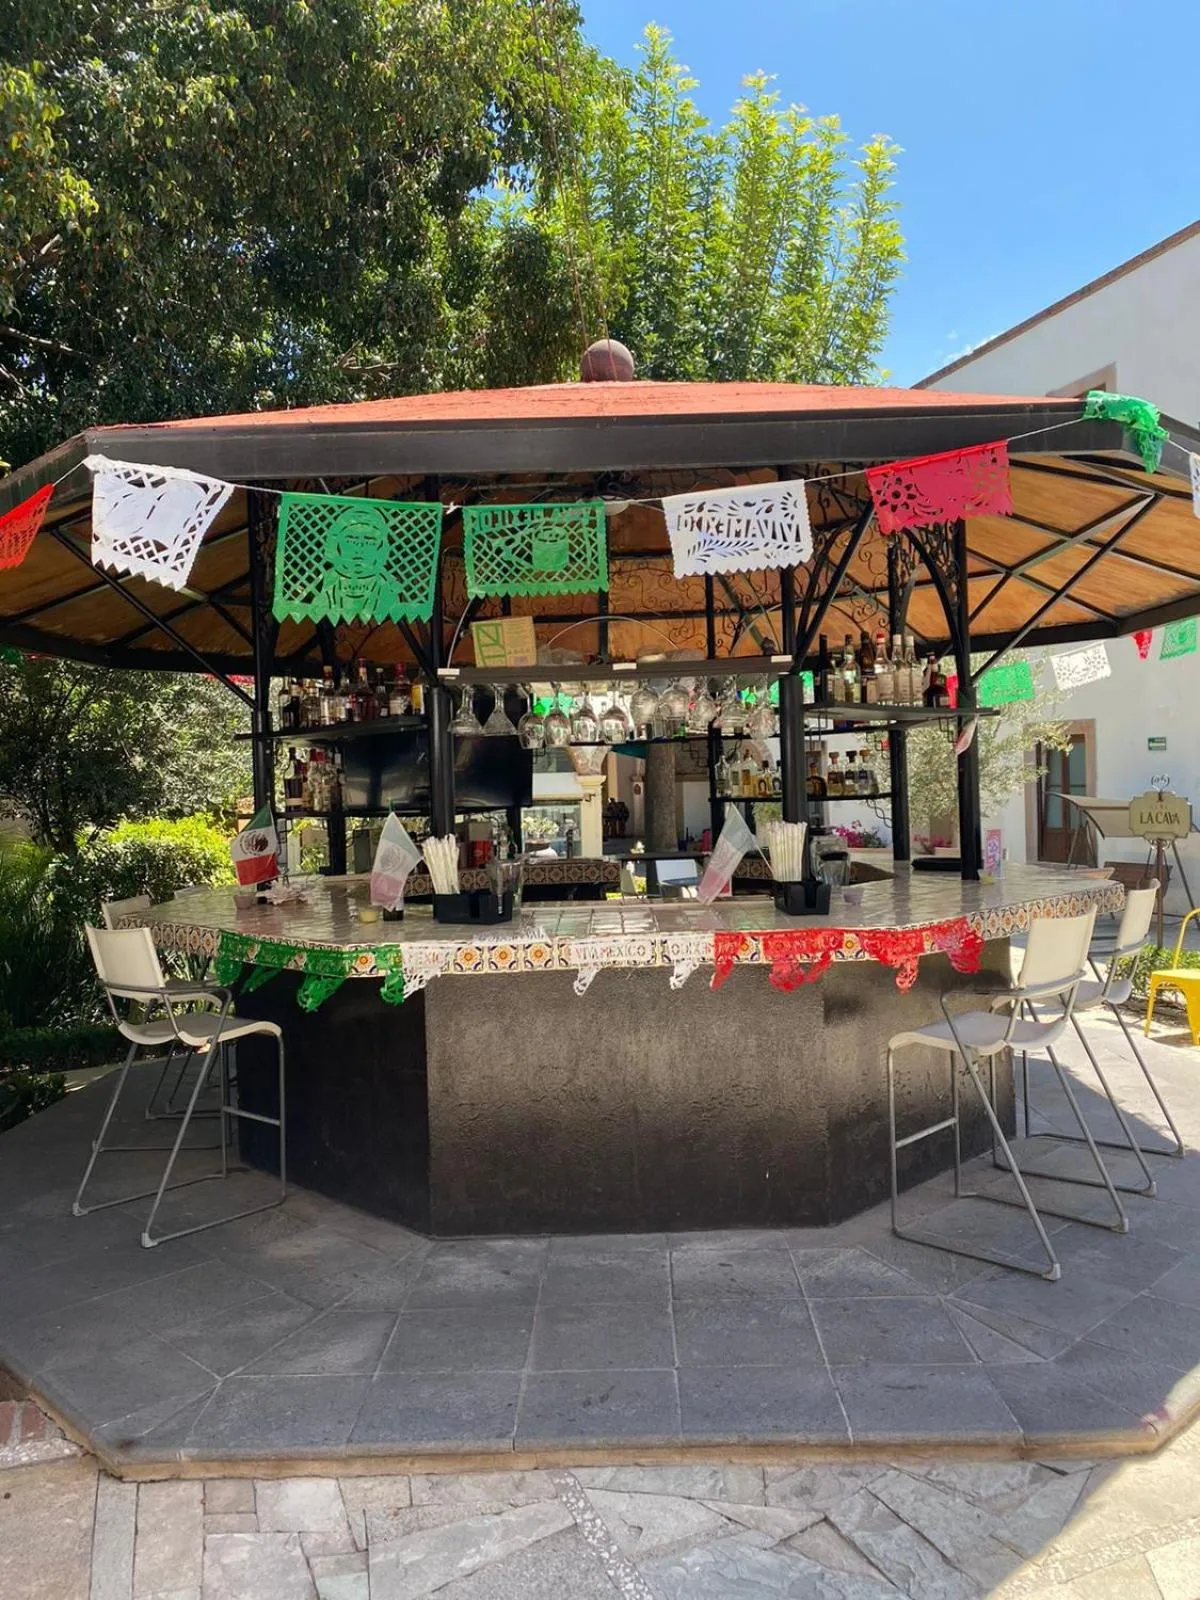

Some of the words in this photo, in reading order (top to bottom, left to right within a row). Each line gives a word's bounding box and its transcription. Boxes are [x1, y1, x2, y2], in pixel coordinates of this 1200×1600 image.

[1140, 812, 1155, 825] LA
[1155, 812, 1180, 825] CAVA
[600, 944, 647, 959] MEXICO
